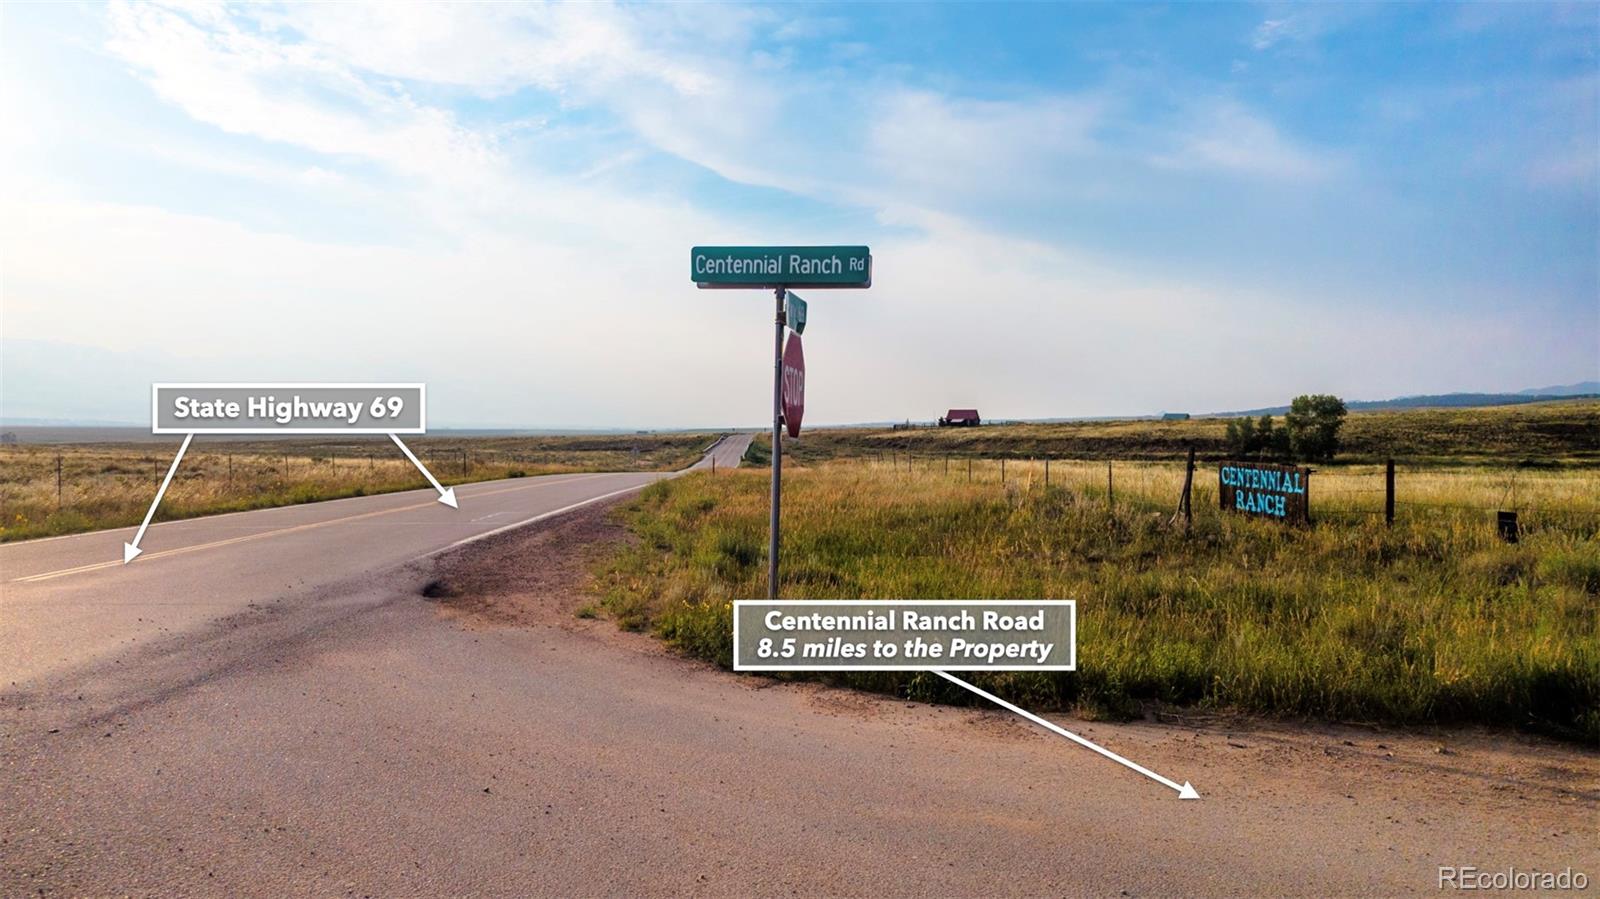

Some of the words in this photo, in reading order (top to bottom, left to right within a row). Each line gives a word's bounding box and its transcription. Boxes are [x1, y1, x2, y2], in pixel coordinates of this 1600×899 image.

[696, 254, 781, 274] Centennial
[789, 254, 841, 274] Ranch
[849, 257, 865, 271] Rd
[784, 365, 804, 405] STOP
[1221, 466, 1304, 494] CENTENNIAL
[1236, 490, 1286, 516] RANCH
